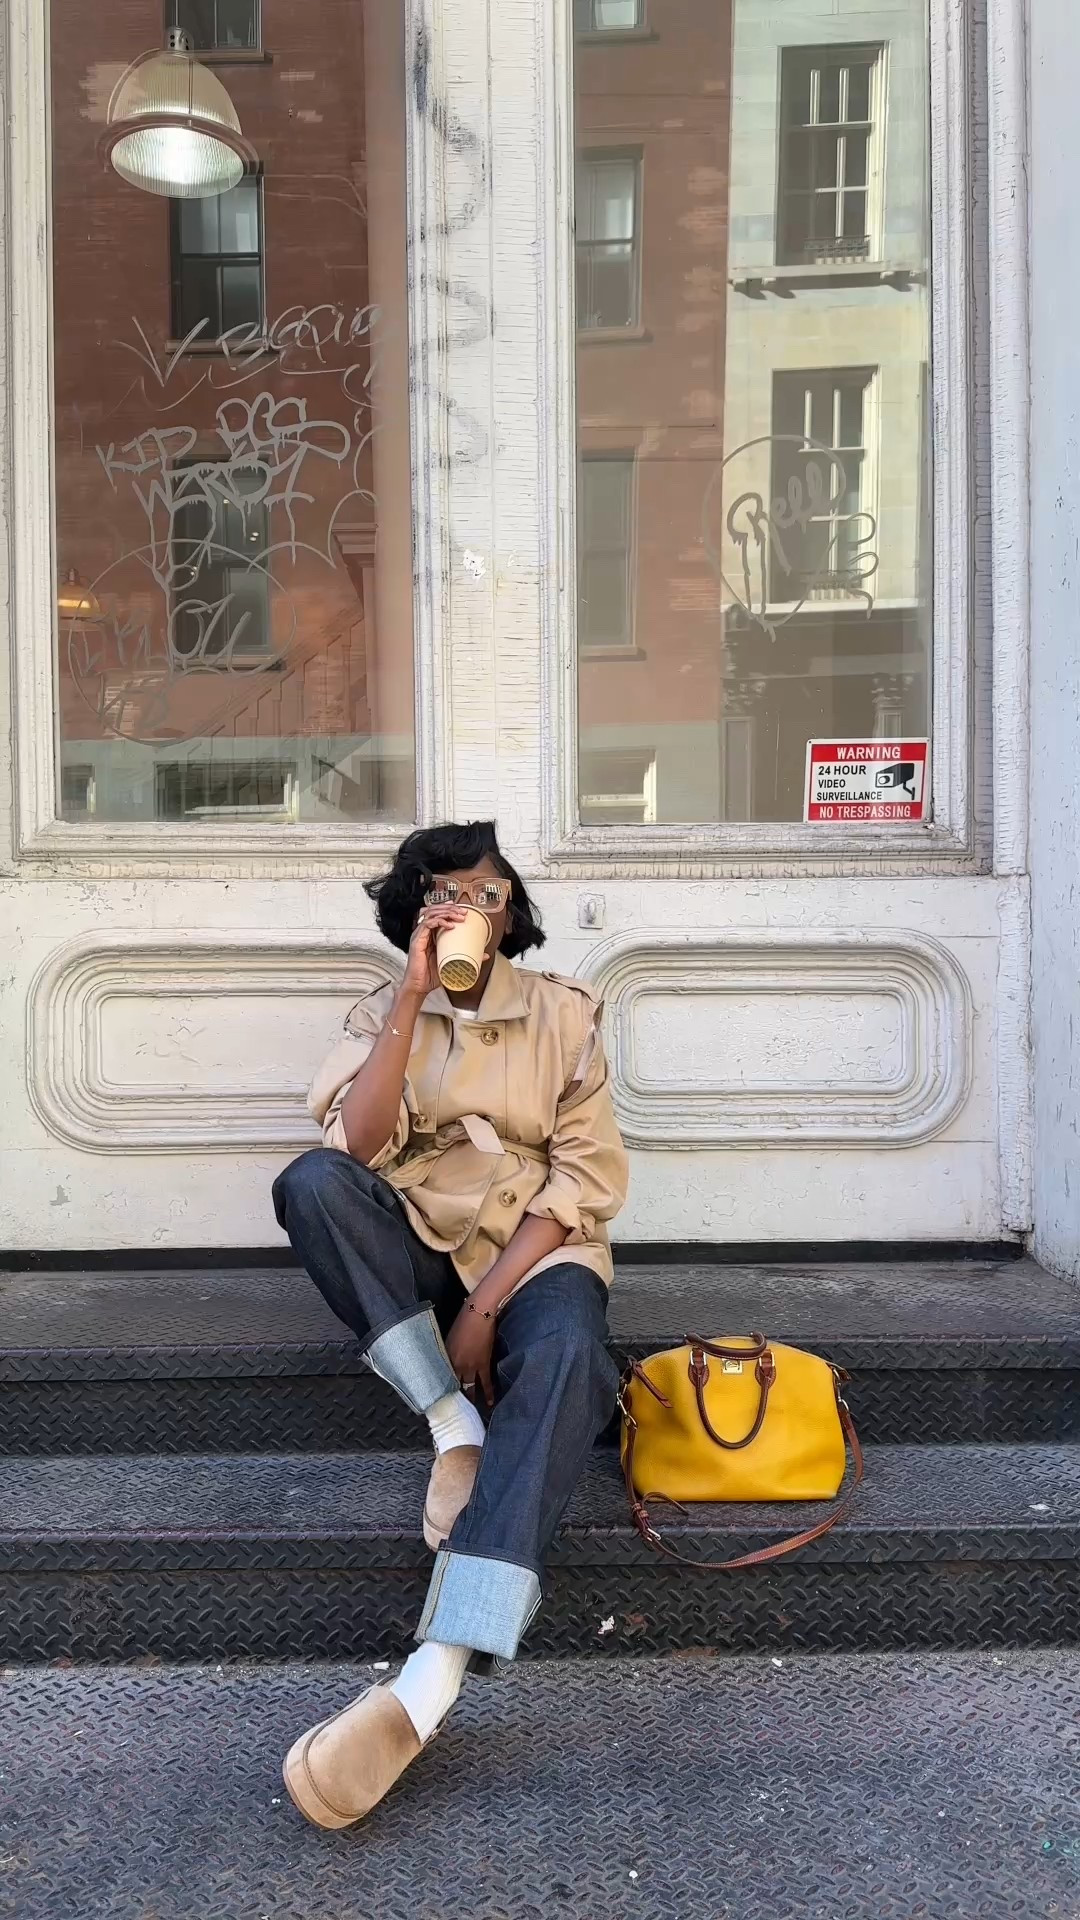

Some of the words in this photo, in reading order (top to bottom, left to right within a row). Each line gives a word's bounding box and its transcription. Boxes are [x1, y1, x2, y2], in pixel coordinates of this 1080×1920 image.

[837, 746, 901, 760] WARNING
[818, 765, 831, 776] 24
[834, 764, 867, 775] HOUR
[818, 779, 846, 789] VIDEO
[816, 791, 882, 801] SURVEILLANCE
[820, 806, 833, 819] NO
[837, 805, 911, 818] TRESPASSING
